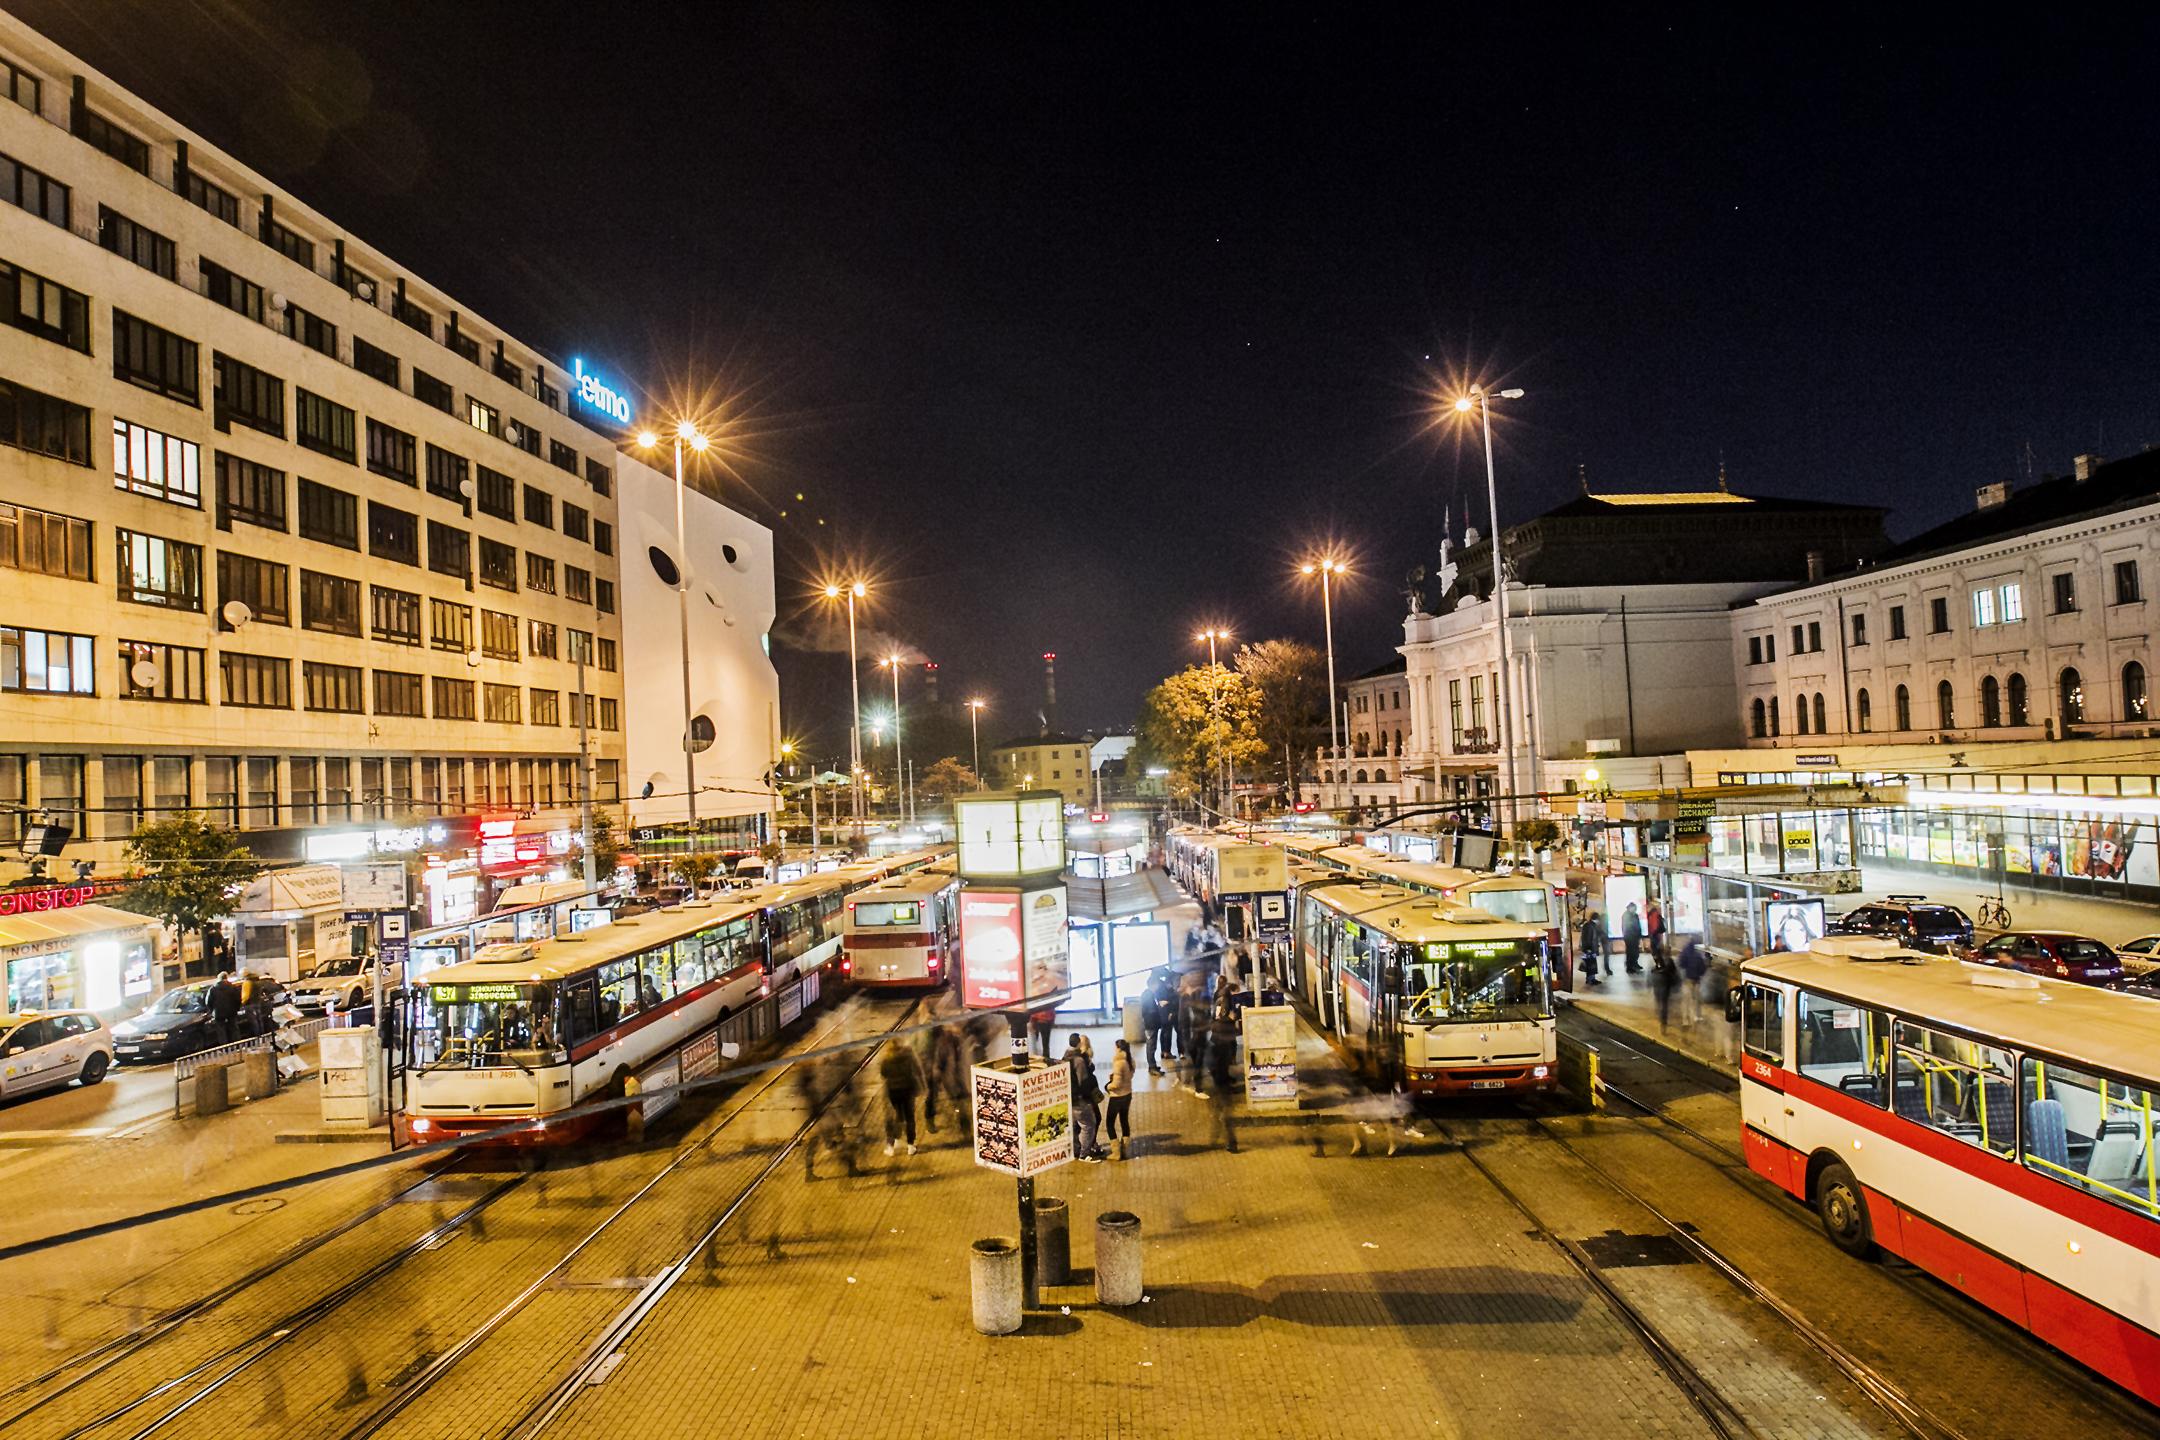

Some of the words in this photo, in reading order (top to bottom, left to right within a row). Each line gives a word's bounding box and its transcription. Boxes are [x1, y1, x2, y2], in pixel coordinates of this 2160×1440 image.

[1678, 809, 1716, 817] EXCHANGE
[639, 829, 655, 841] 131
[11, 943, 40, 957] NON
[1754, 1062, 1772, 1078] 2364
